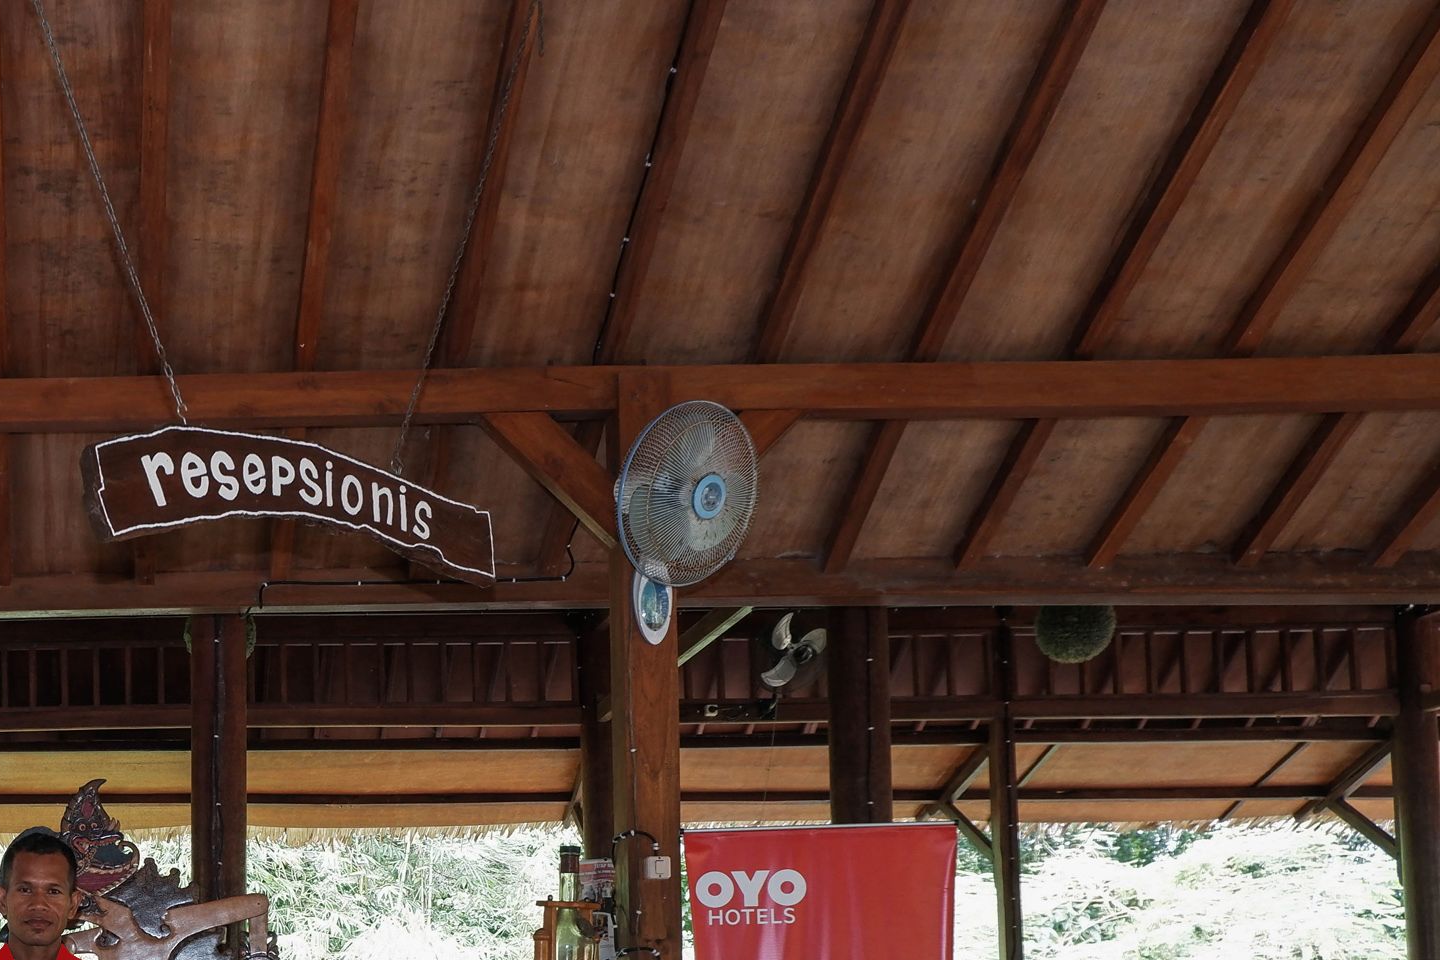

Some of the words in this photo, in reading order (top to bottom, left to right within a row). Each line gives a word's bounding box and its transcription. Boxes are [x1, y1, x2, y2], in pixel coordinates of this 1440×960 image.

[140, 450, 434, 541] resepsionis
[695, 868, 807, 908] OYO
[708, 907, 796, 926] HOTELS
